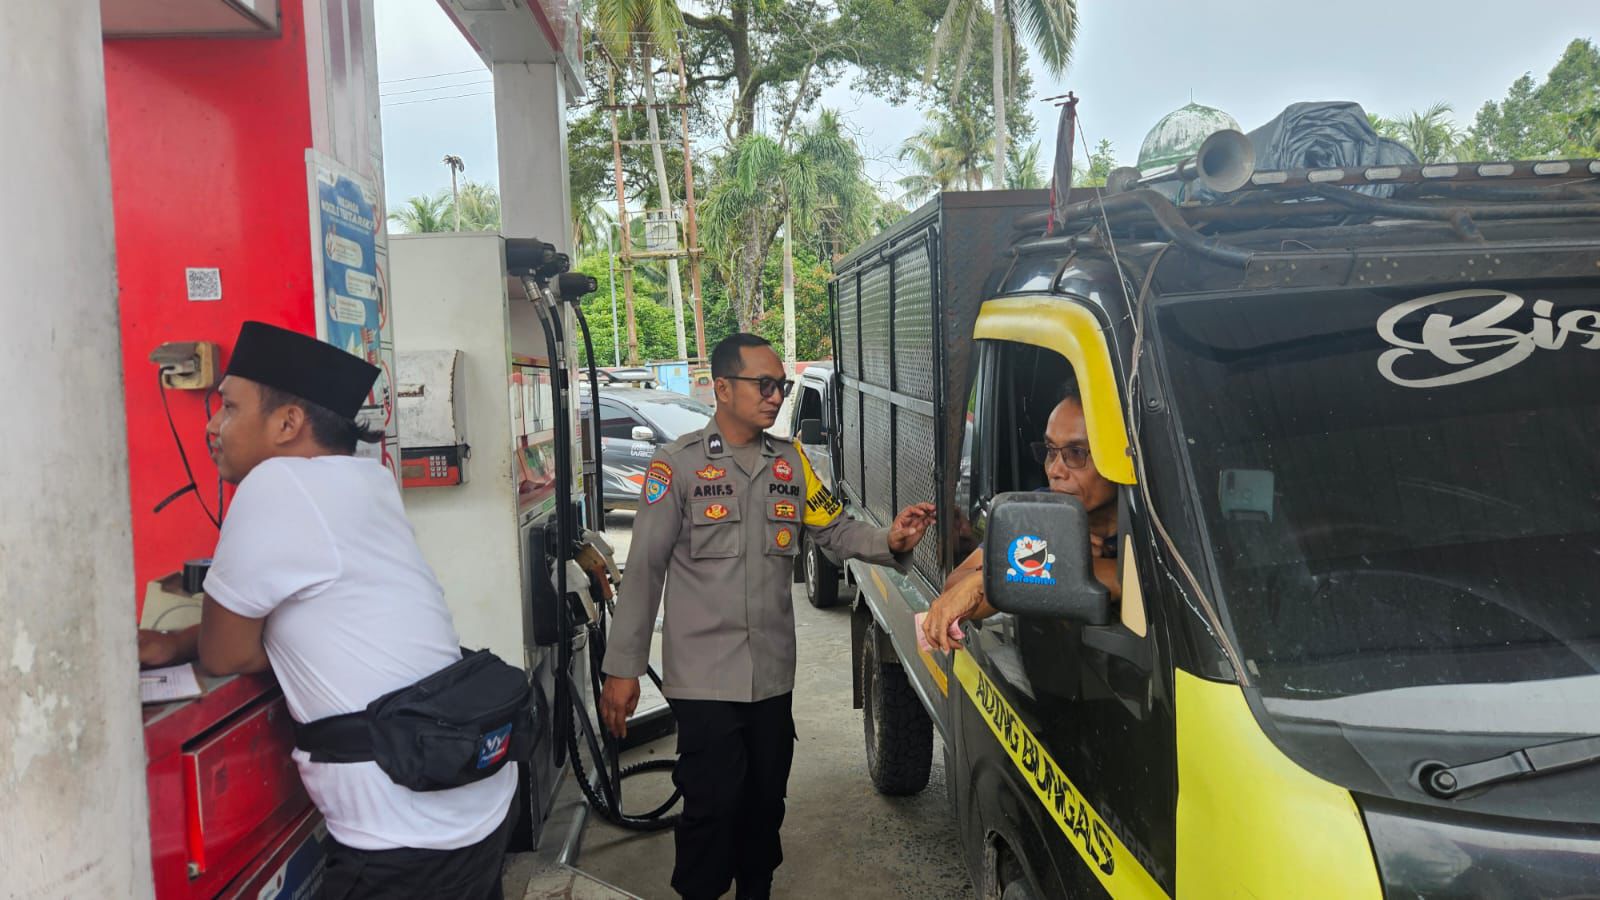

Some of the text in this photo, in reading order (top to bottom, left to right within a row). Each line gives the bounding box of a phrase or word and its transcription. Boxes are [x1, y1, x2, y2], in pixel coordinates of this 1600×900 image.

[693, 484, 734, 497] ARIF.S
[769, 483, 800, 497] POLRI
[975, 671, 1115, 876] ADING BUNGAS
